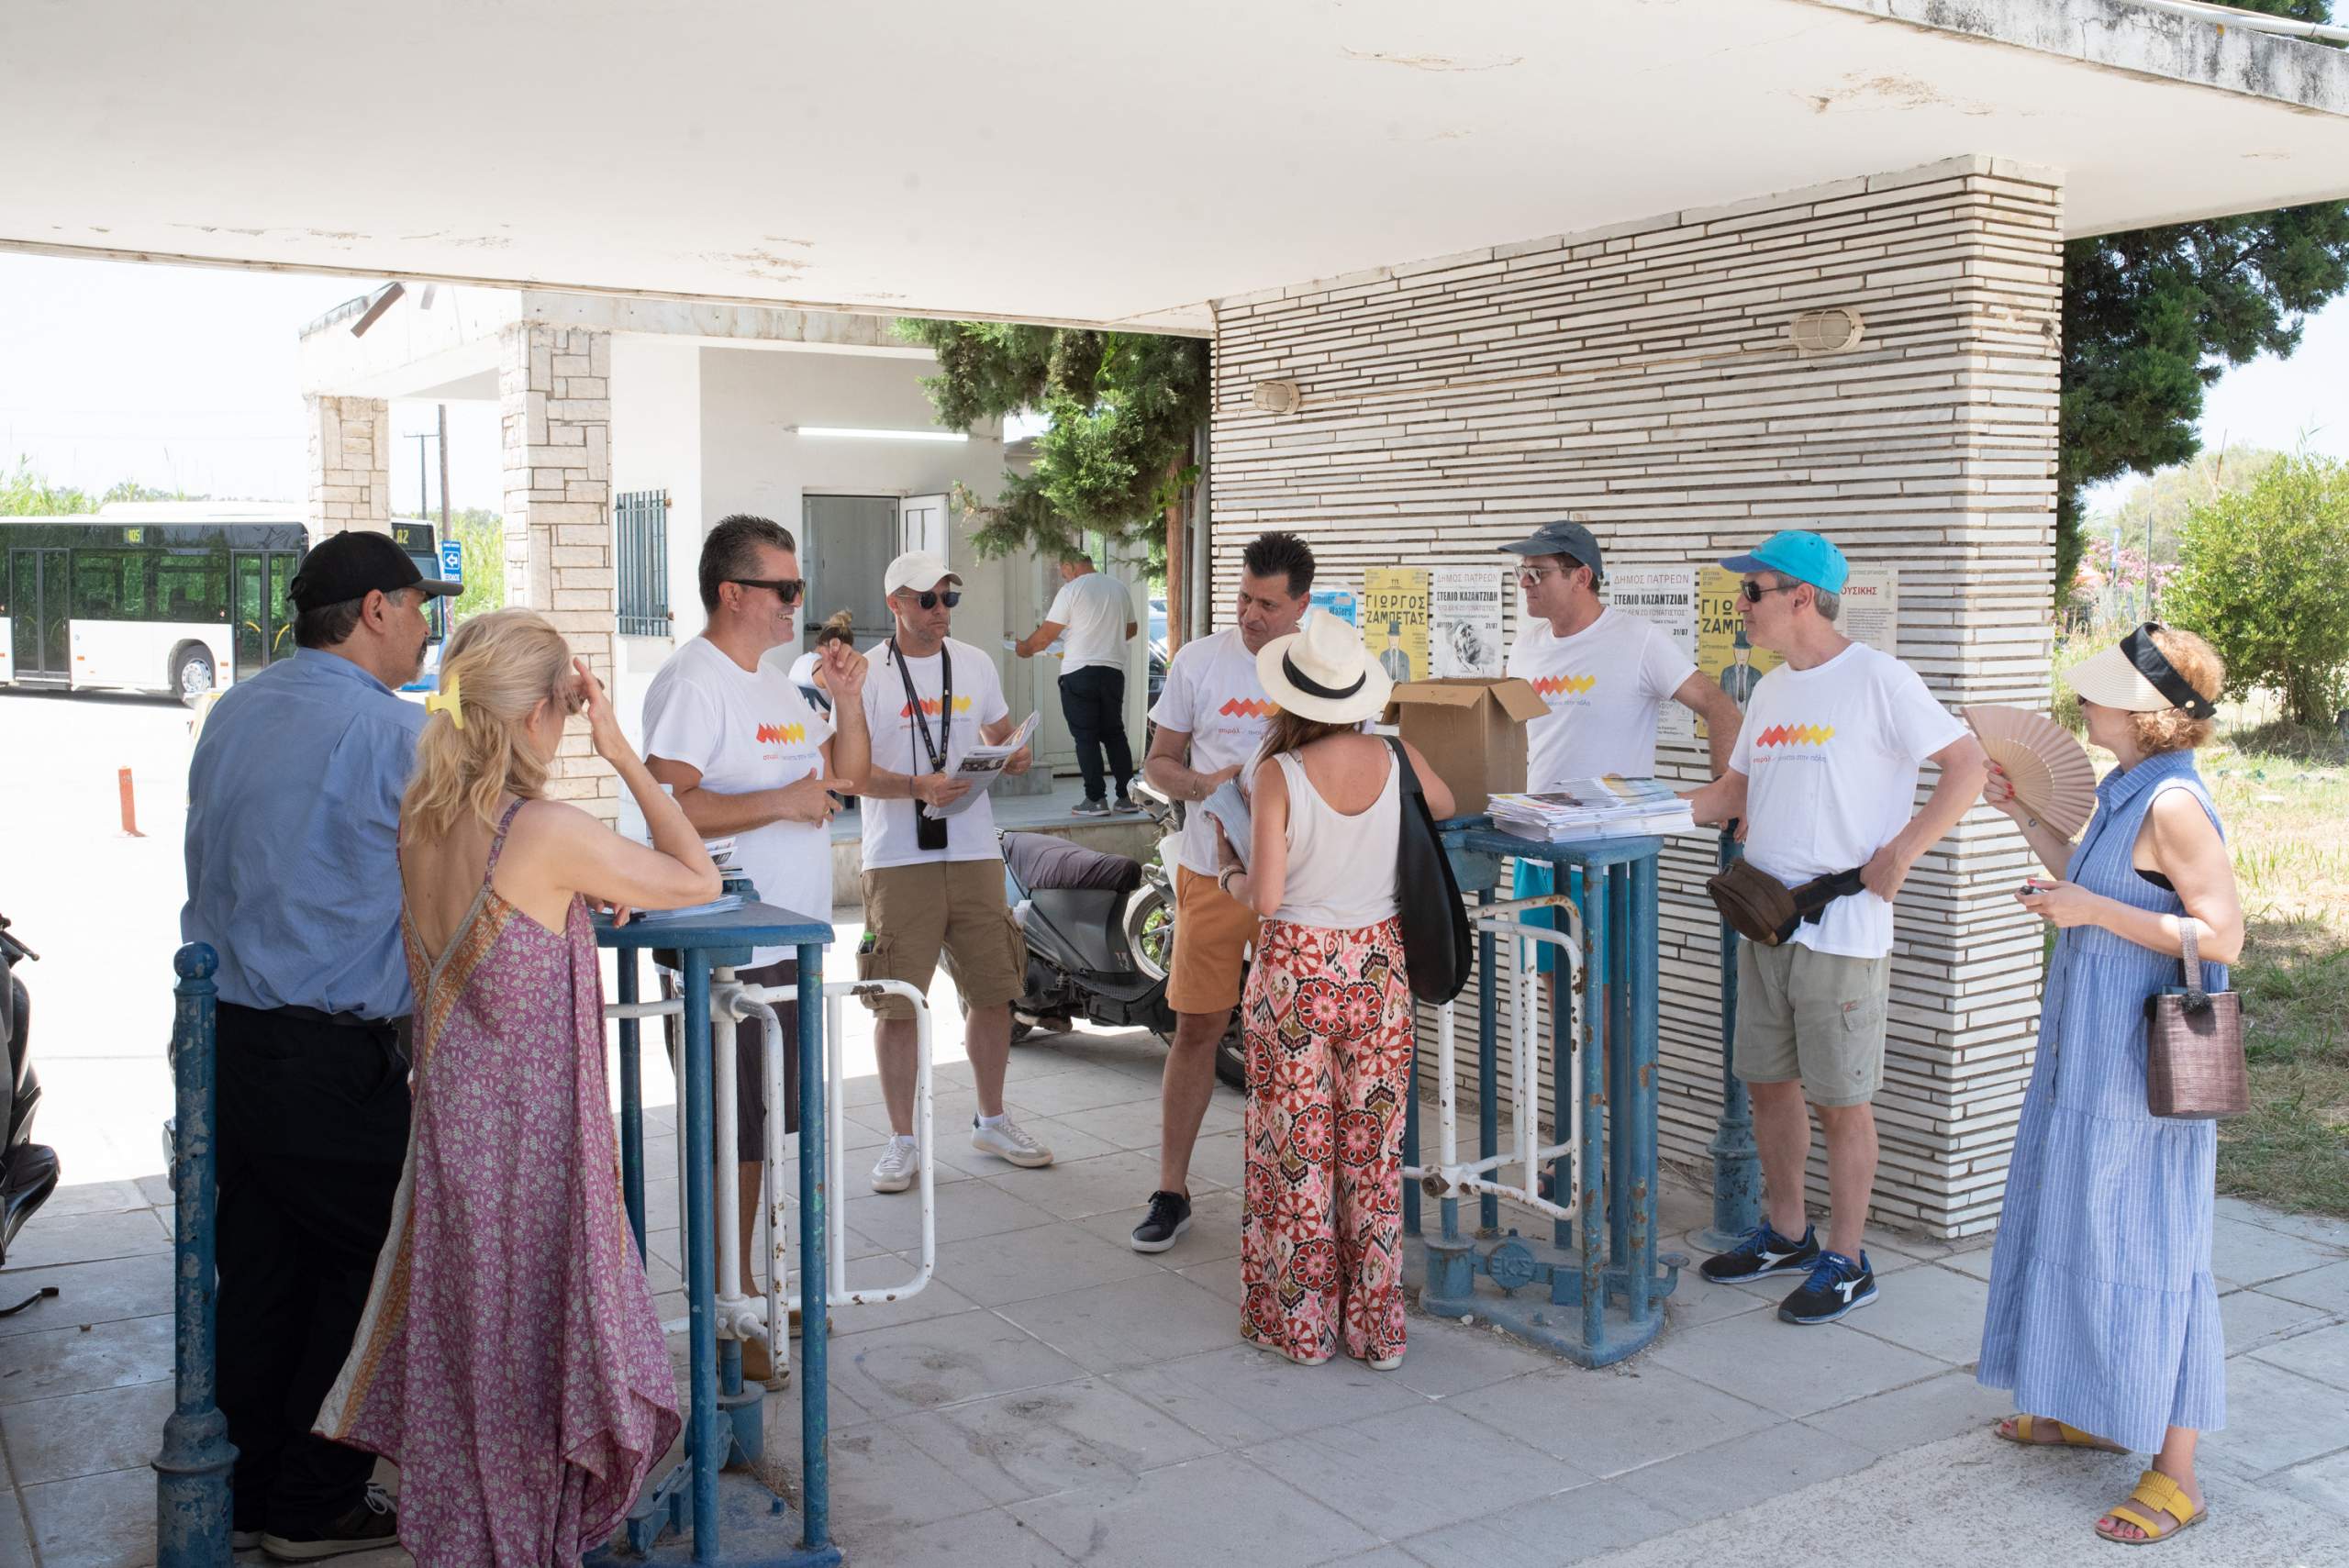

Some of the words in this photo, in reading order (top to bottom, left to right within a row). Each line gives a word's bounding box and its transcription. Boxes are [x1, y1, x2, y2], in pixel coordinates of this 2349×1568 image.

[1614, 574, 1645, 584] ΔΗΜΟΣ
[1647, 573, 1689, 584] ΠΑΤΡΕΩΝ
[1437, 591, 1458, 602] ΣΤΕΛΙΟ
[1459, 591, 1498, 602] ΚΑΖΑΝΤΖΙΔΗ
[1614, 594, 1640, 606] ΣΤΕΛΙΟ
[1641, 594, 1688, 606] ΚΑΖΑΝΤΖΙΔΗ
[1329, 606, 1353, 617] Waters
[1701, 598, 1742, 617] ΓΙΩ
[1366, 611, 1425, 626] ΖΑΜΠΕΤΑΣ
